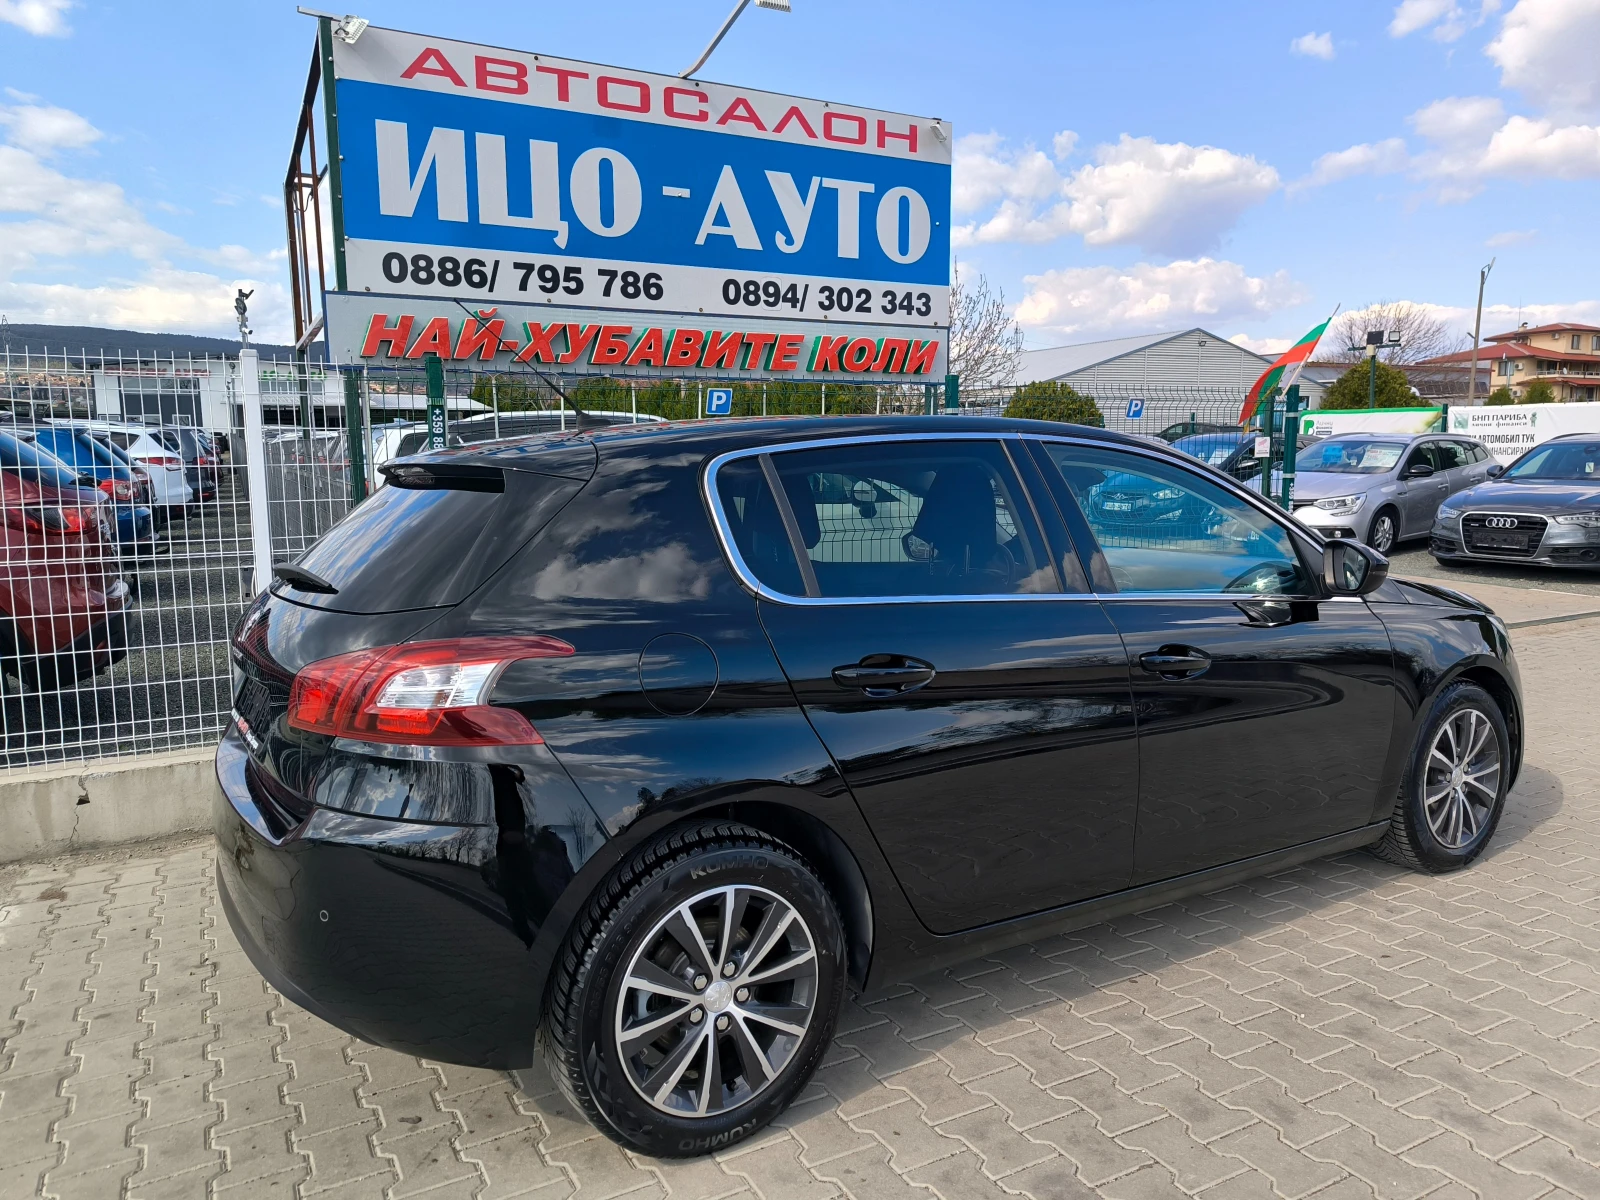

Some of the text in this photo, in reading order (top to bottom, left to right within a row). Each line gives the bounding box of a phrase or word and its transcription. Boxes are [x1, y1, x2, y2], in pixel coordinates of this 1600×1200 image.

[401, 47, 919, 154] АВТОСАЛОН
[375, 118, 642, 250] ИЦО
[382, 251, 664, 301] 0886/ 795 786
[722, 278, 932, 317] 0894/ 302 343
[360, 306, 940, 375] НАЙ-ХУБАВИТЕ КОЛИ
[711, 392, 727, 411] P
[1472, 413, 1527, 422] БНП ПАРИБА
[432, 408, 443, 434] +359
[1521, 433, 1536, 444] ТУК
[690, 855, 769, 880] KUMHO
[678, 1118, 757, 1151] KUMHO
